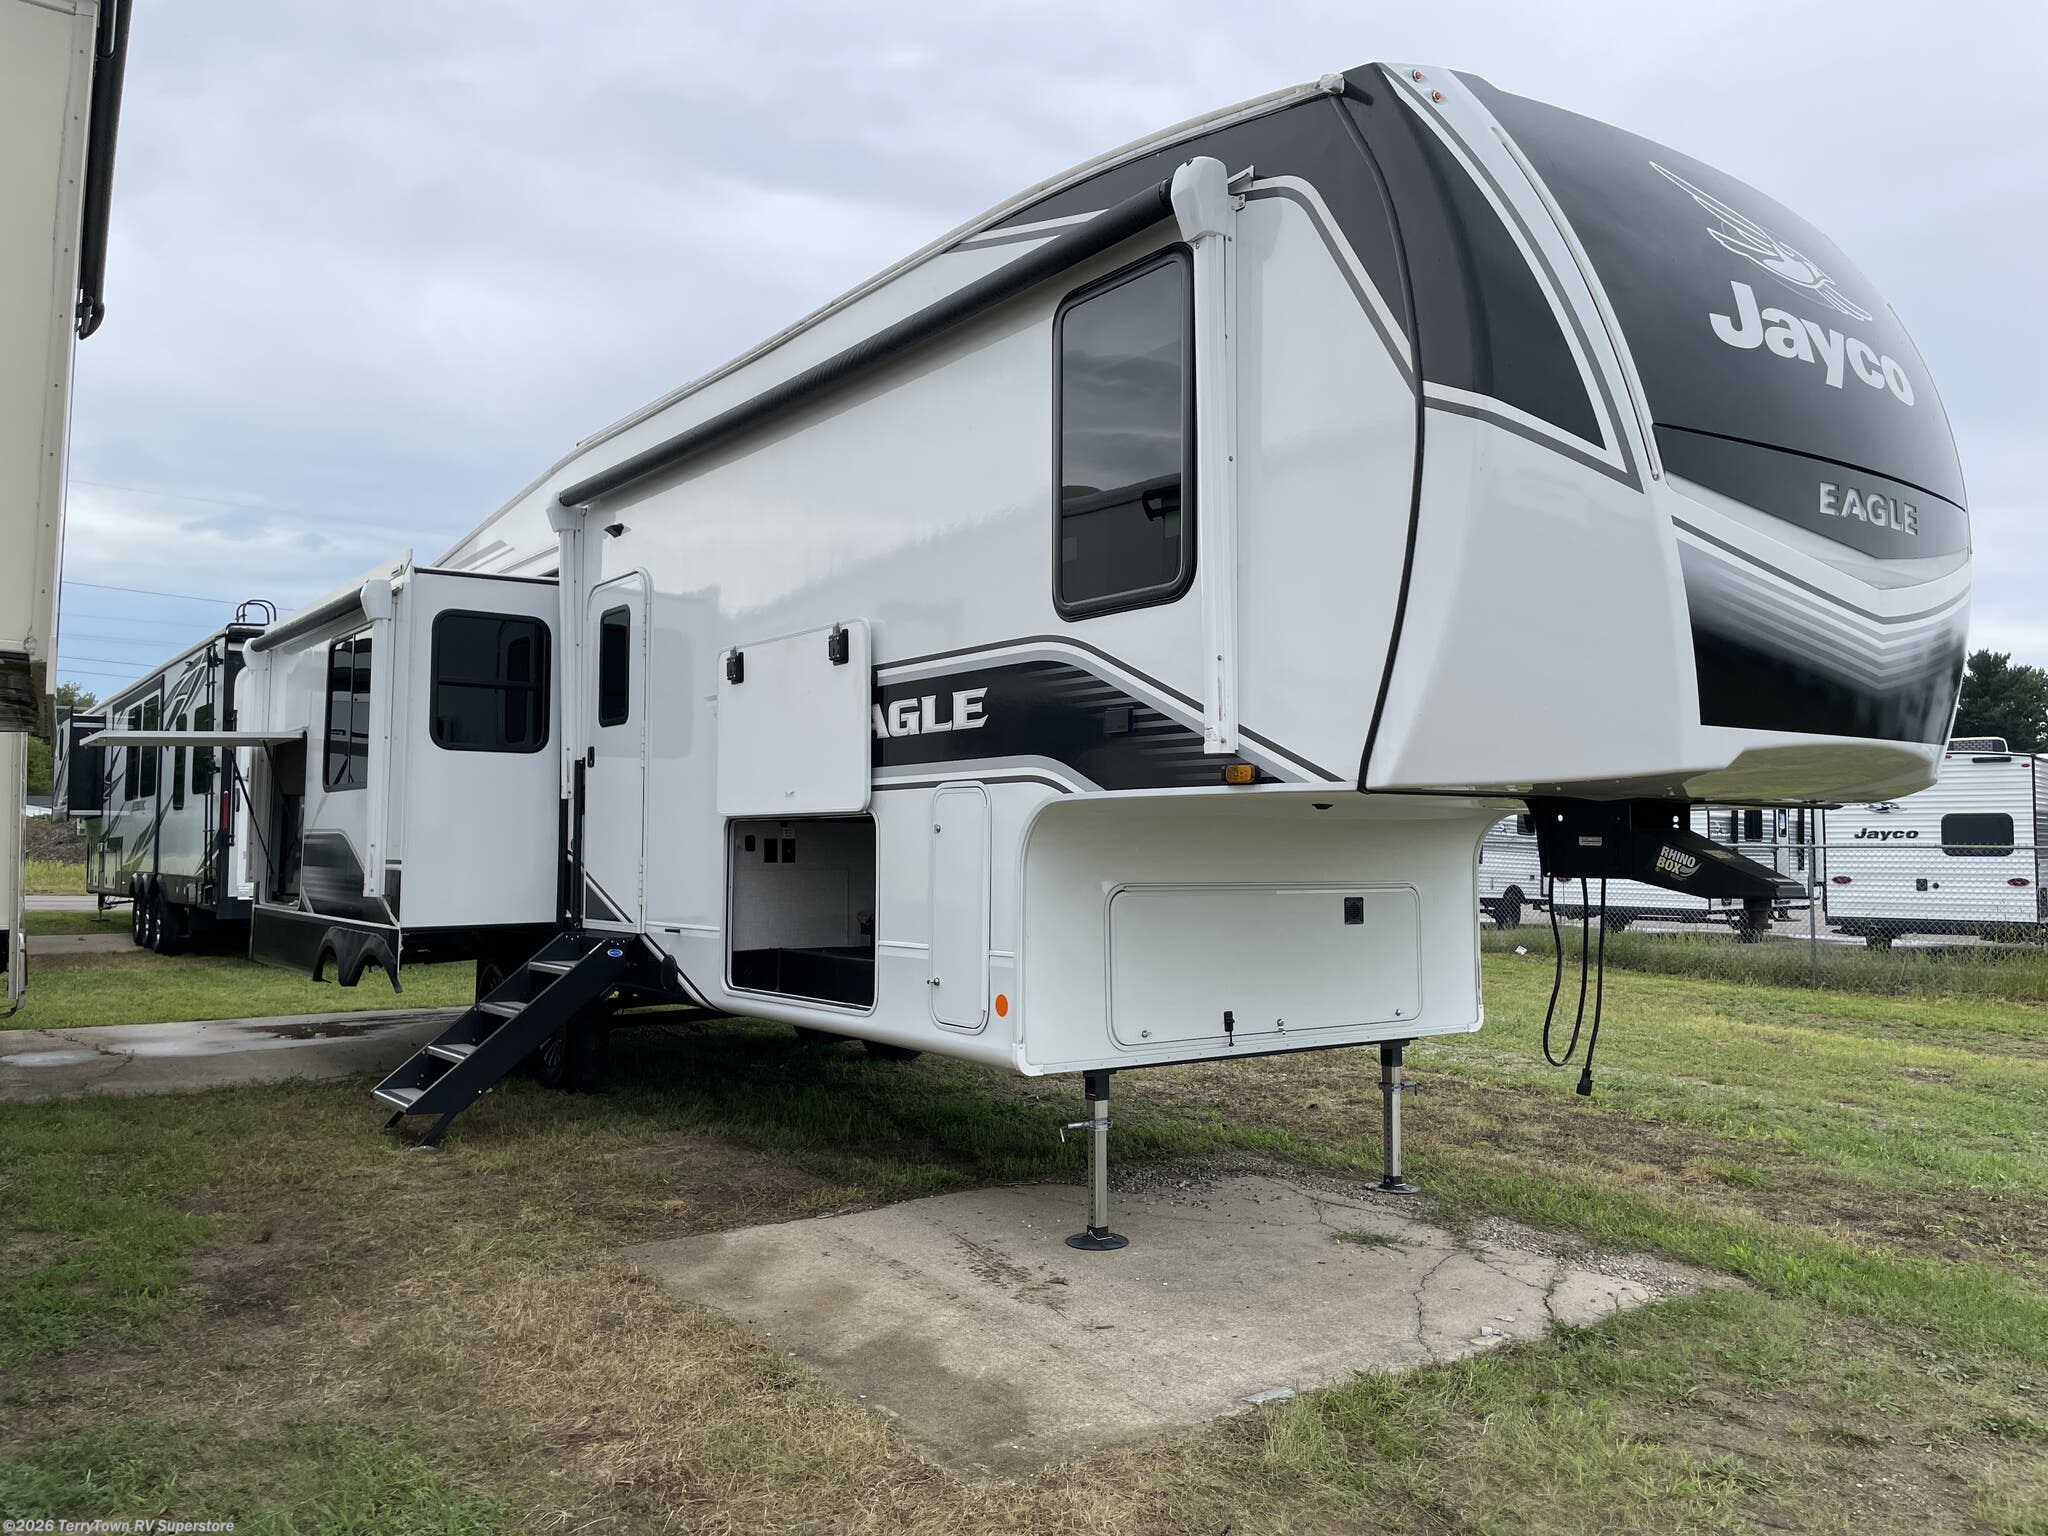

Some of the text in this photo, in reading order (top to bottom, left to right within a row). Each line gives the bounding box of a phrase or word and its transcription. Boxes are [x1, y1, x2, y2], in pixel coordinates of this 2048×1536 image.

[1709, 280, 1915, 406] Jayco
[1820, 481, 1918, 536] EAGLE
[871, 687, 989, 739] AGLE
[1854, 828, 1919, 841] Jayco
[1656, 856, 1682, 875] BOX
[1660, 845, 1696, 868] RHINO
